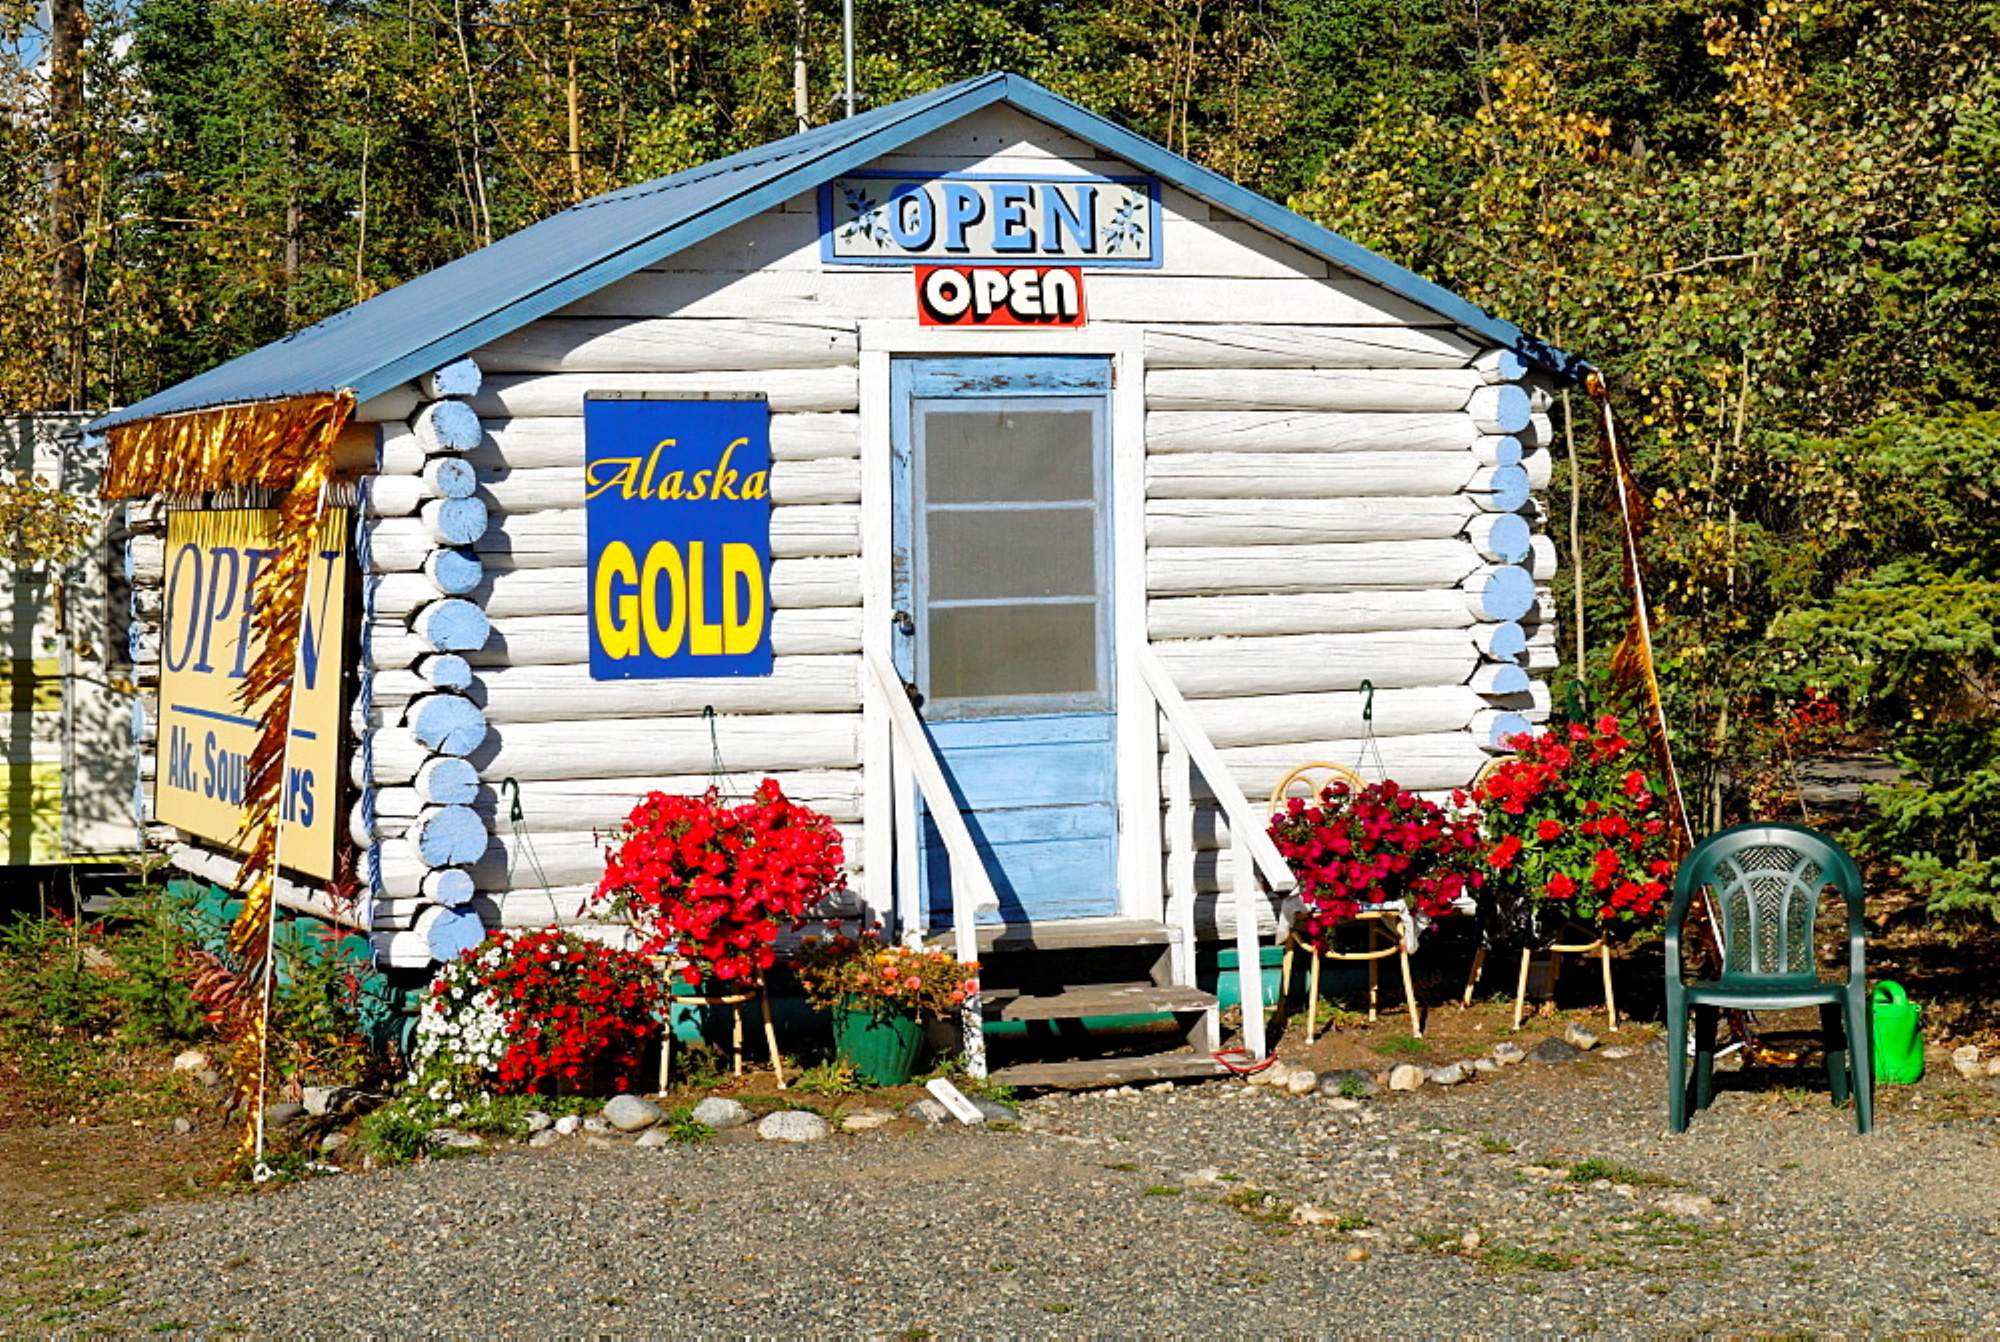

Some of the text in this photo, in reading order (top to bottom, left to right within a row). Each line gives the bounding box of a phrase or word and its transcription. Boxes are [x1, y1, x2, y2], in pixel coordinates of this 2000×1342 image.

[888, 183, 1097, 253] OPEN
[921, 267, 1079, 323] OPEN
[585, 437, 768, 501] Alaska
[594, 540, 765, 660] GOLD
[168, 725, 315, 828] Ak. Sours
